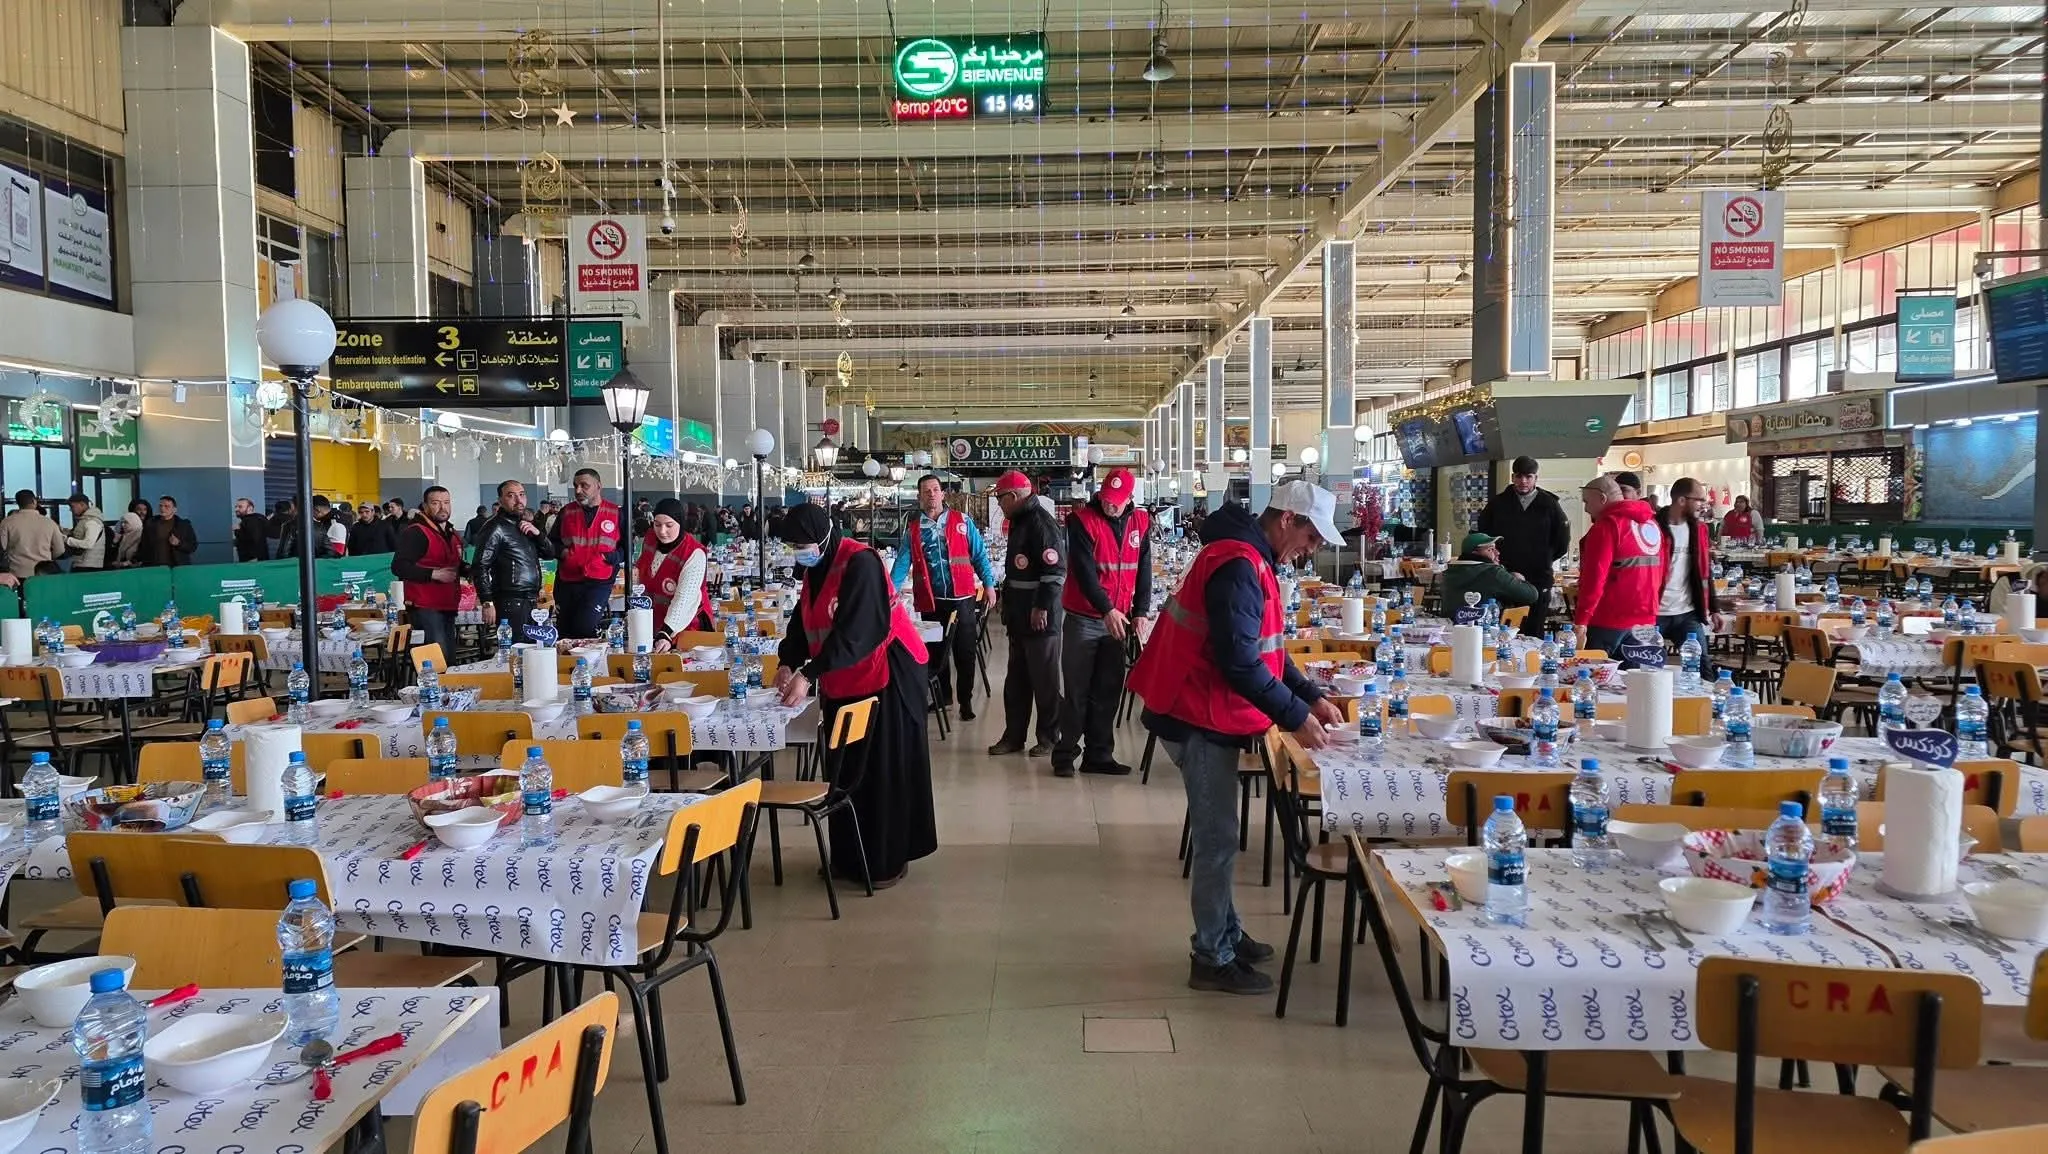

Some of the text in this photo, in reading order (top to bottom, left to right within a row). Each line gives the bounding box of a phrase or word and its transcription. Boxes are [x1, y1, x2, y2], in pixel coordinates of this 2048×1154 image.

[961, 46, 1043, 68] مرحبا بكم
[962, 68, 1043, 82] BIENVENUE
[986, 94, 1034, 112] 15 45
[1715, 246, 1769, 254] NO SMOKING
[1715, 255, 1770, 267] ممنوع التدخين
[582, 267, 634, 277] NO SMOKING
[1910, 308, 1944, 321] مصلى
[336, 326, 460, 350] Zone 3
[507, 330, 558, 346] منطقة
[579, 332, 611, 345] مصلى
[372, 355, 391, 365] toutes
[392, 354, 426, 365] destination
[336, 379, 404, 391] Embarquement
[526, 377, 560, 390] ركوب
[975, 436, 1061, 448] CAFETERIA
[1020, 448, 1056, 459] GARE
[1458, 610, 1482, 619] Cotex
[526, 628, 553, 640] كوتكس
[1628, 649, 1664, 664] كوتكس
[8, 670, 37, 680] CRA
[1895, 736, 1951, 760] كوتكس
[569, 856, 584, 896] Cotex
[600, 857, 615, 899] Cotex
[630, 858, 647, 901] Cotex
[419, 902, 441, 936] Cotex
[452, 903, 472, 941] Cotex
[485, 905, 503, 945] Cotex
[517, 906, 532, 949] Cotex
[550, 908, 566, 954] Cotex
[580, 911, 596, 957] Cotex
[608, 914, 624, 960] Cotex
[1788, 980, 1894, 1015] CRA
[1453, 986, 1477, 1039] Cotex
[1496, 987, 1520, 1041] Cotex
[1539, 987, 1562, 1041] Cotex
[1582, 987, 1606, 1041] Cotex
[1625, 988, 1649, 1041] Cotex
[1669, 988, 1692, 1042] Cotex
[491, 1040, 562, 1112] CRA
[174, 1099, 225, 1134] Cotex
[232, 1099, 280, 1134] Cotex
